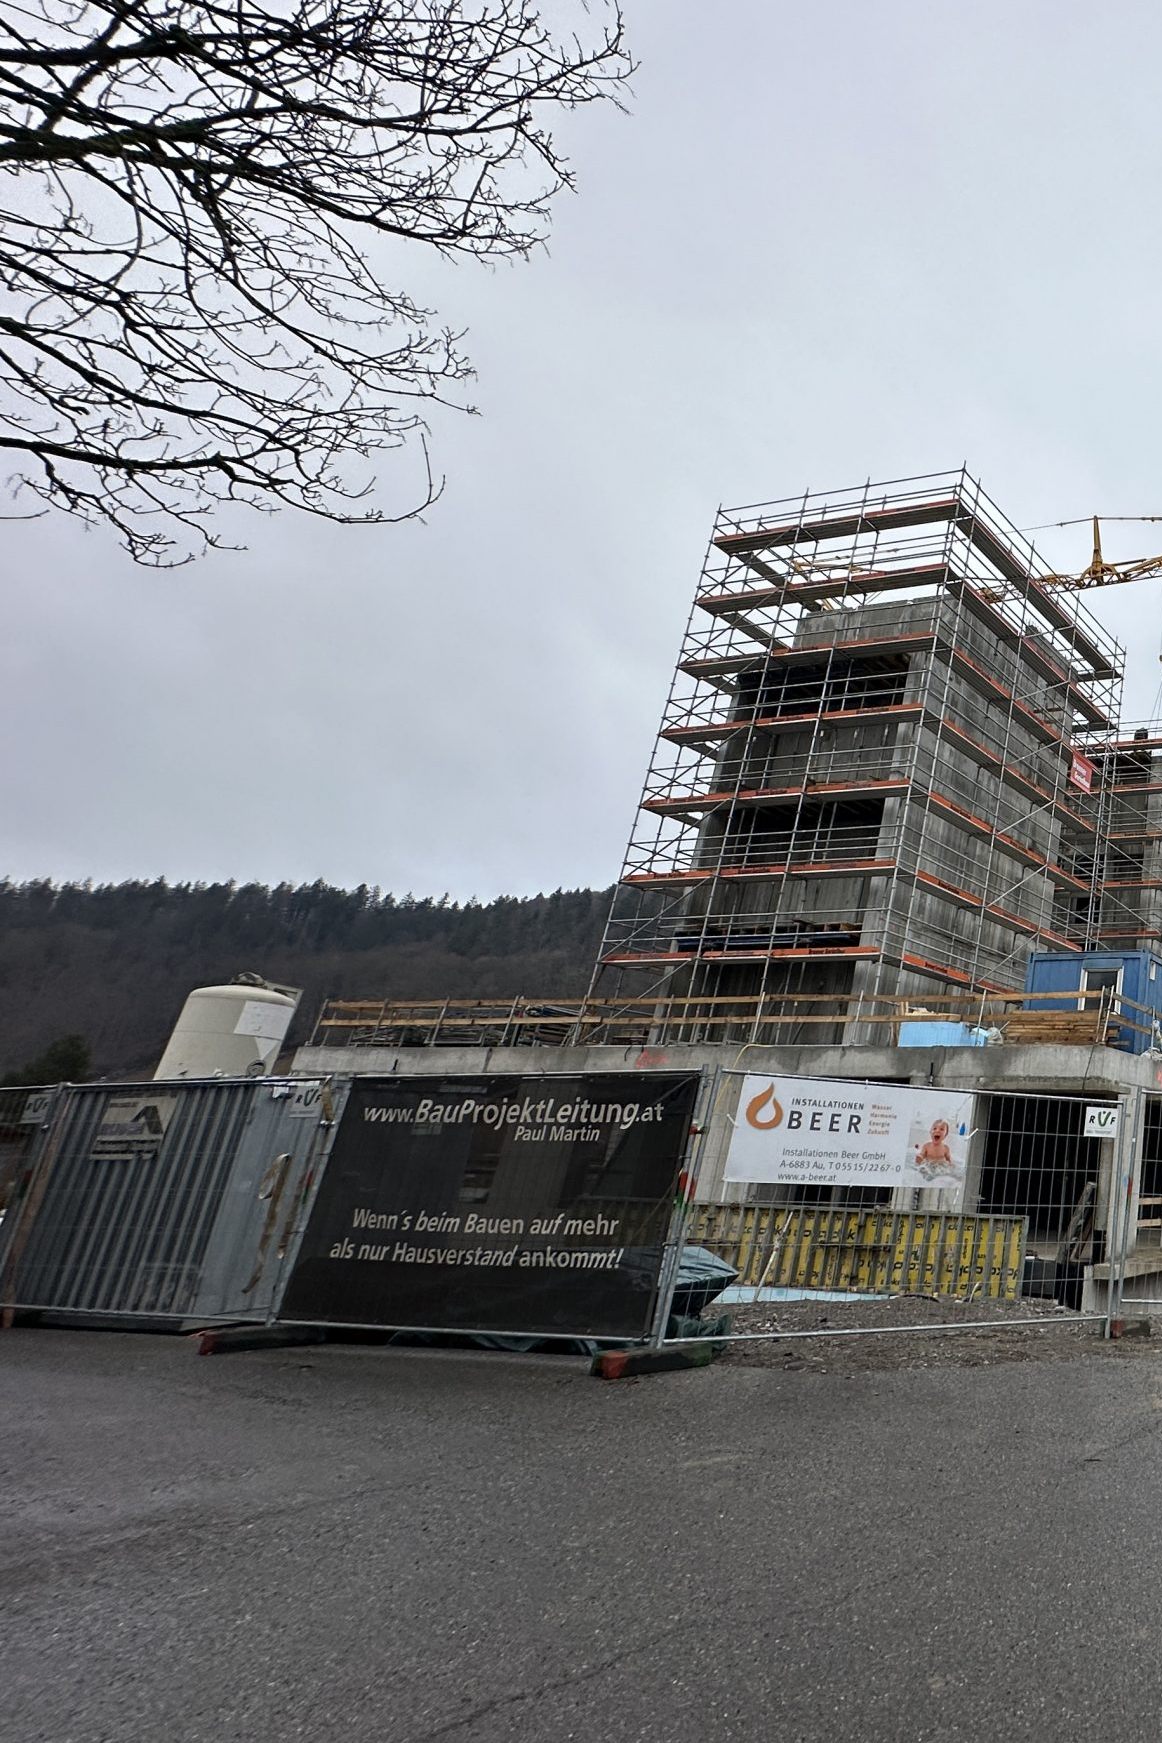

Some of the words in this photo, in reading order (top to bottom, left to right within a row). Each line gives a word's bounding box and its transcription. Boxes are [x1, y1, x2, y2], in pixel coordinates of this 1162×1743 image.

[791, 1097, 865, 1110] INSTALLATIONEN
[365, 1096, 664, 1130] www.BauProjektLeitung.at
[787, 1110, 862, 1133] BEER
[514, 1125, 547, 1142] Paul
[549, 1125, 600, 1142] Martin
[782, 1148, 838, 1158] Installationen
[841, 1150, 860, 1159] Beer
[862, 1151, 886, 1160] GmbH
[779, 1159, 810, 1169] A-6883
[777, 1173, 837, 1182] www.a-beer.at
[414, 1210, 461, 1233] beim
[464, 1213, 524, 1235] Bauen
[530, 1213, 565, 1235] auf
[563, 1213, 620, 1236] mehr
[329, 1237, 355, 1259] als
[357, 1243, 391, 1261] nur
[391, 1242, 518, 1266] Hausverstand
[519, 1245, 624, 1269] ankommt!
